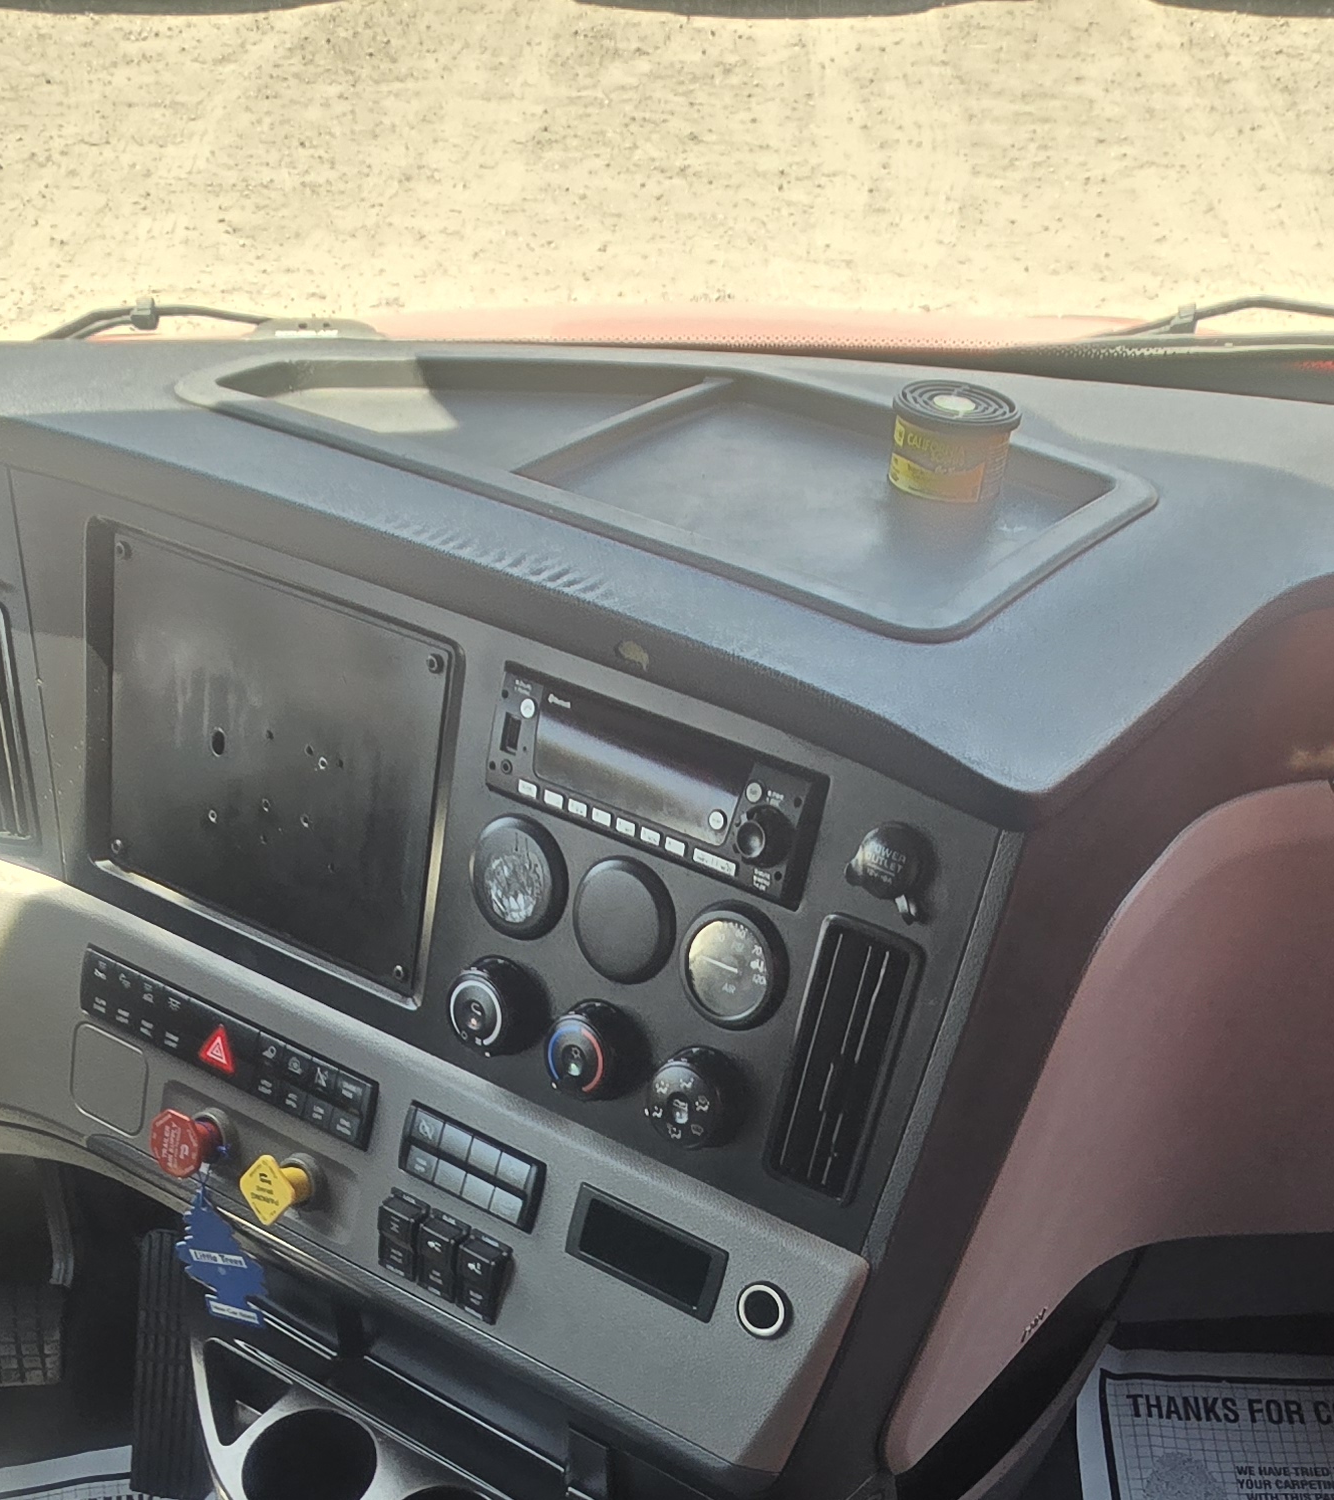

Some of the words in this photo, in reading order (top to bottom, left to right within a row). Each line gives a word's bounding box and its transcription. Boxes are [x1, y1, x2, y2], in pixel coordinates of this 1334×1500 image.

[864, 851, 904, 874] OUTLET
[870, 840, 907, 865] POWER
[1126, 1394, 1240, 1424] THANKS
[1247, 1398, 1306, 1425] FOR
[1236, 1465, 1255, 1476] WE
[1258, 1466, 1290, 1477] HAVE
[1291, 1466, 1331, 1477] TRIED
[1236, 1479, 1272, 1490] YOUR
